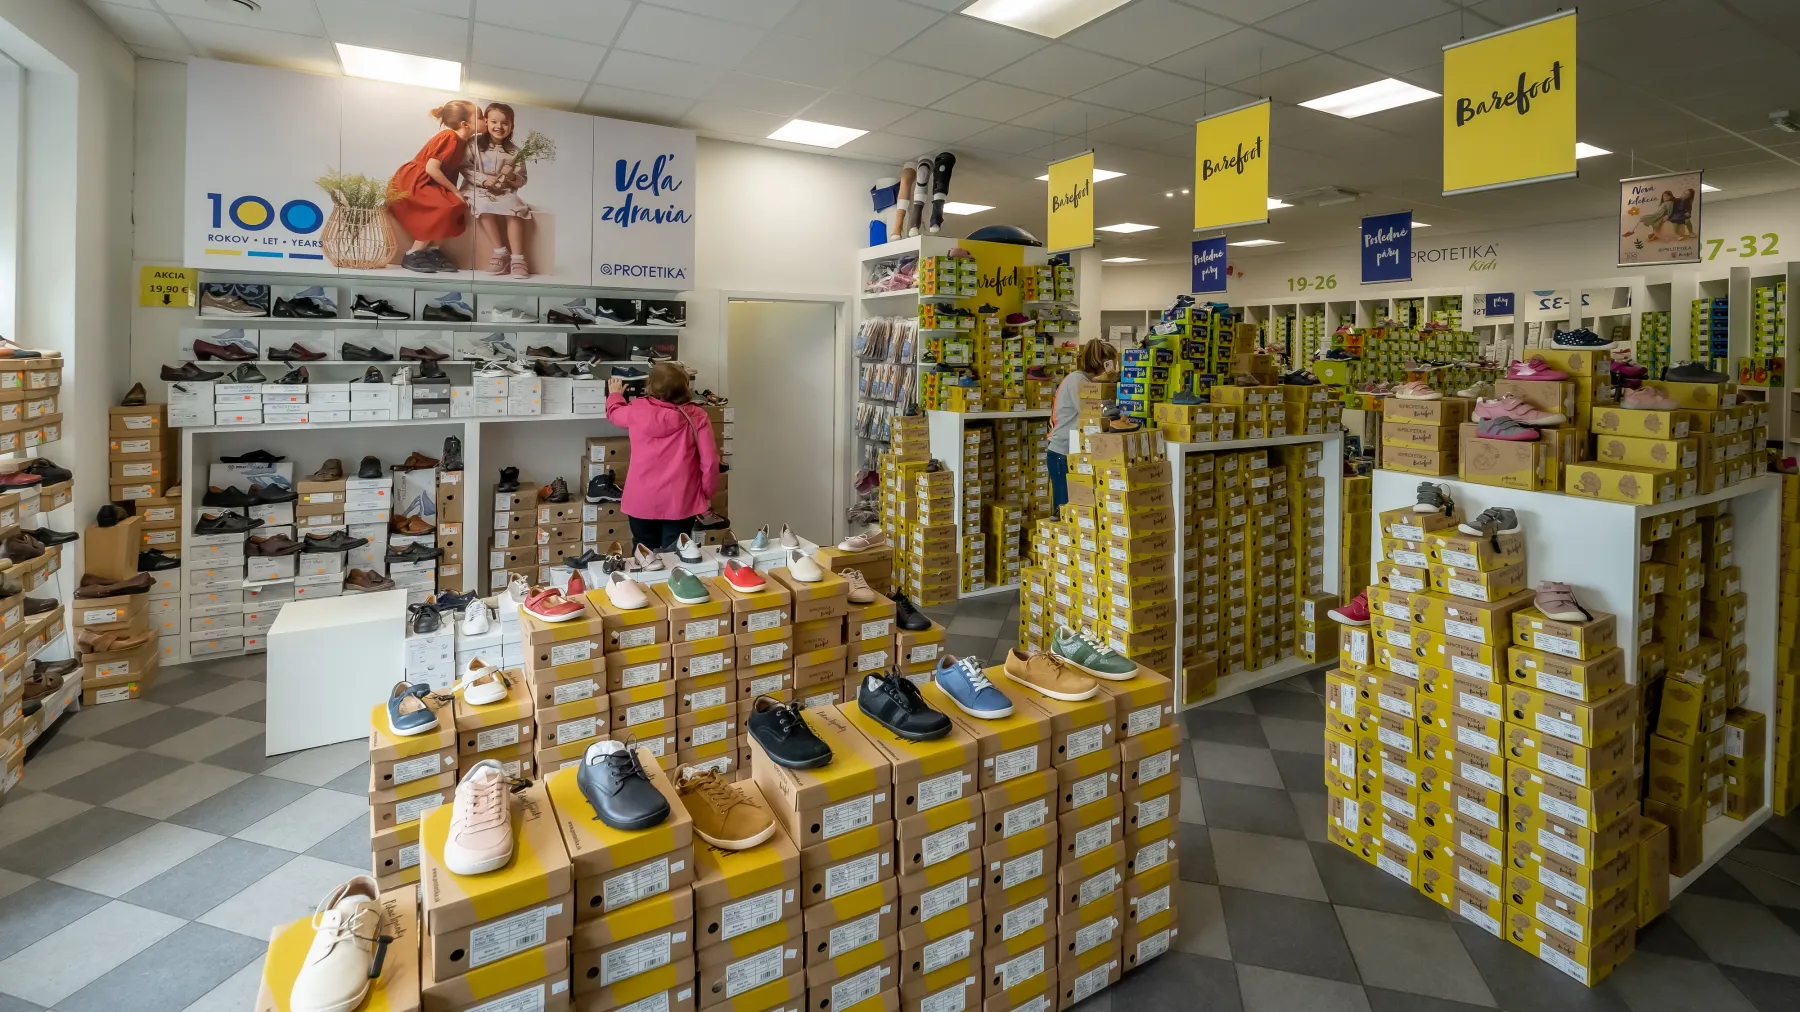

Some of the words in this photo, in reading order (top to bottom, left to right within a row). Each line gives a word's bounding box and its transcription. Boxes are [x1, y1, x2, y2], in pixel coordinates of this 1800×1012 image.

[1455, 60, 1565, 128] Barefoot
[1201, 136, 1263, 182] Barefoot
[1051, 178, 1090, 214] Barefoot
[207, 192, 324, 235] 100
[601, 190, 692, 228] zdravia
[207, 232, 249, 245] ROKOV
[262, 236, 279, 246] LET
[291, 238, 324, 249] YEARS
[1365, 226, 1408, 250] Posledné
[1700, 232, 1779, 261] 7-32
[1194, 248, 1224, 266] Posledné
[1376, 246, 1400, 267] páry
[1468, 258, 1497, 272] Kids
[154, 271, 185, 280] AKCIA
[614, 263, 685, 280] PROTETIKA
[976, 265, 1018, 297] arefoot
[1202, 265, 1218, 281] páry
[150, 285, 178, 294] 19,90
[1287, 273, 1338, 292] 19-26
